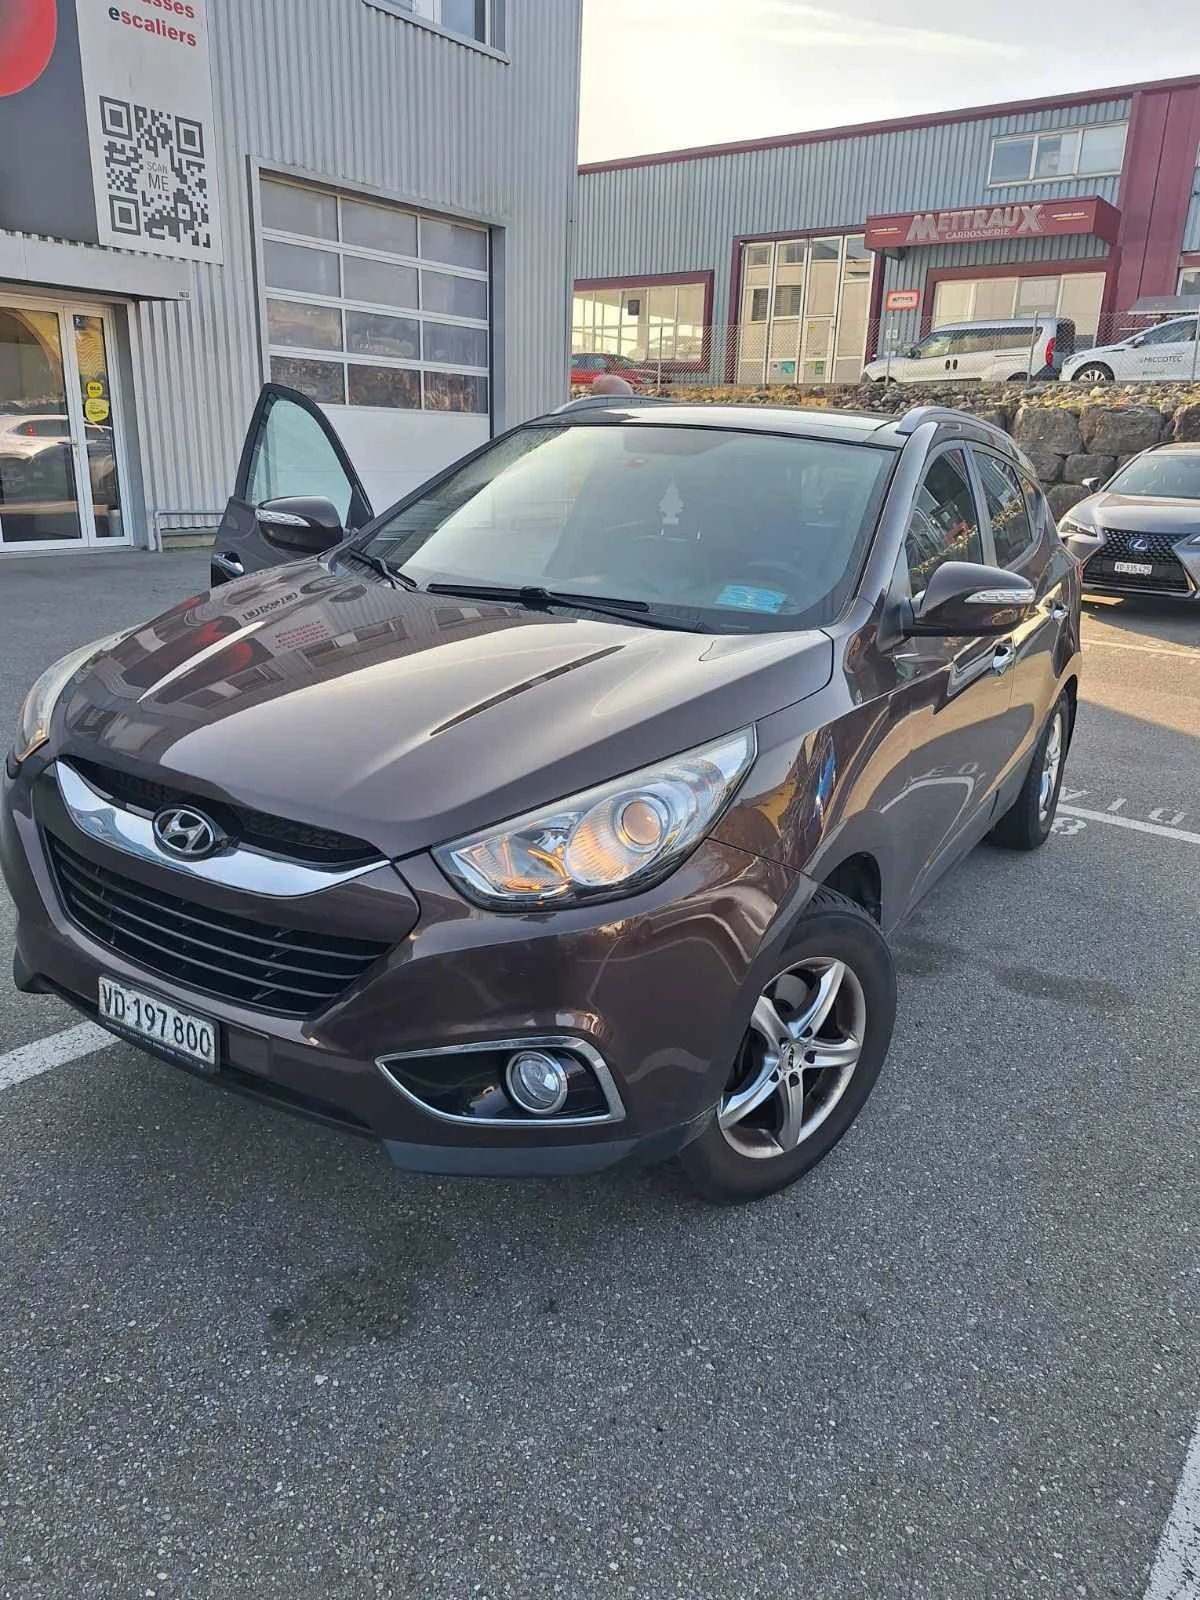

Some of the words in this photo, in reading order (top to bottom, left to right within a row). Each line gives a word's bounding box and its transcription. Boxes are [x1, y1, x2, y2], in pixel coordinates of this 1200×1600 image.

[108, 6, 197, 46] escaliers
[146, 160, 168, 174] SCAN
[148, 172, 169, 191] ME
[906, 205, 1041, 241] METTRAUX
[945, 227, 1011, 240] CARROSSERIE
